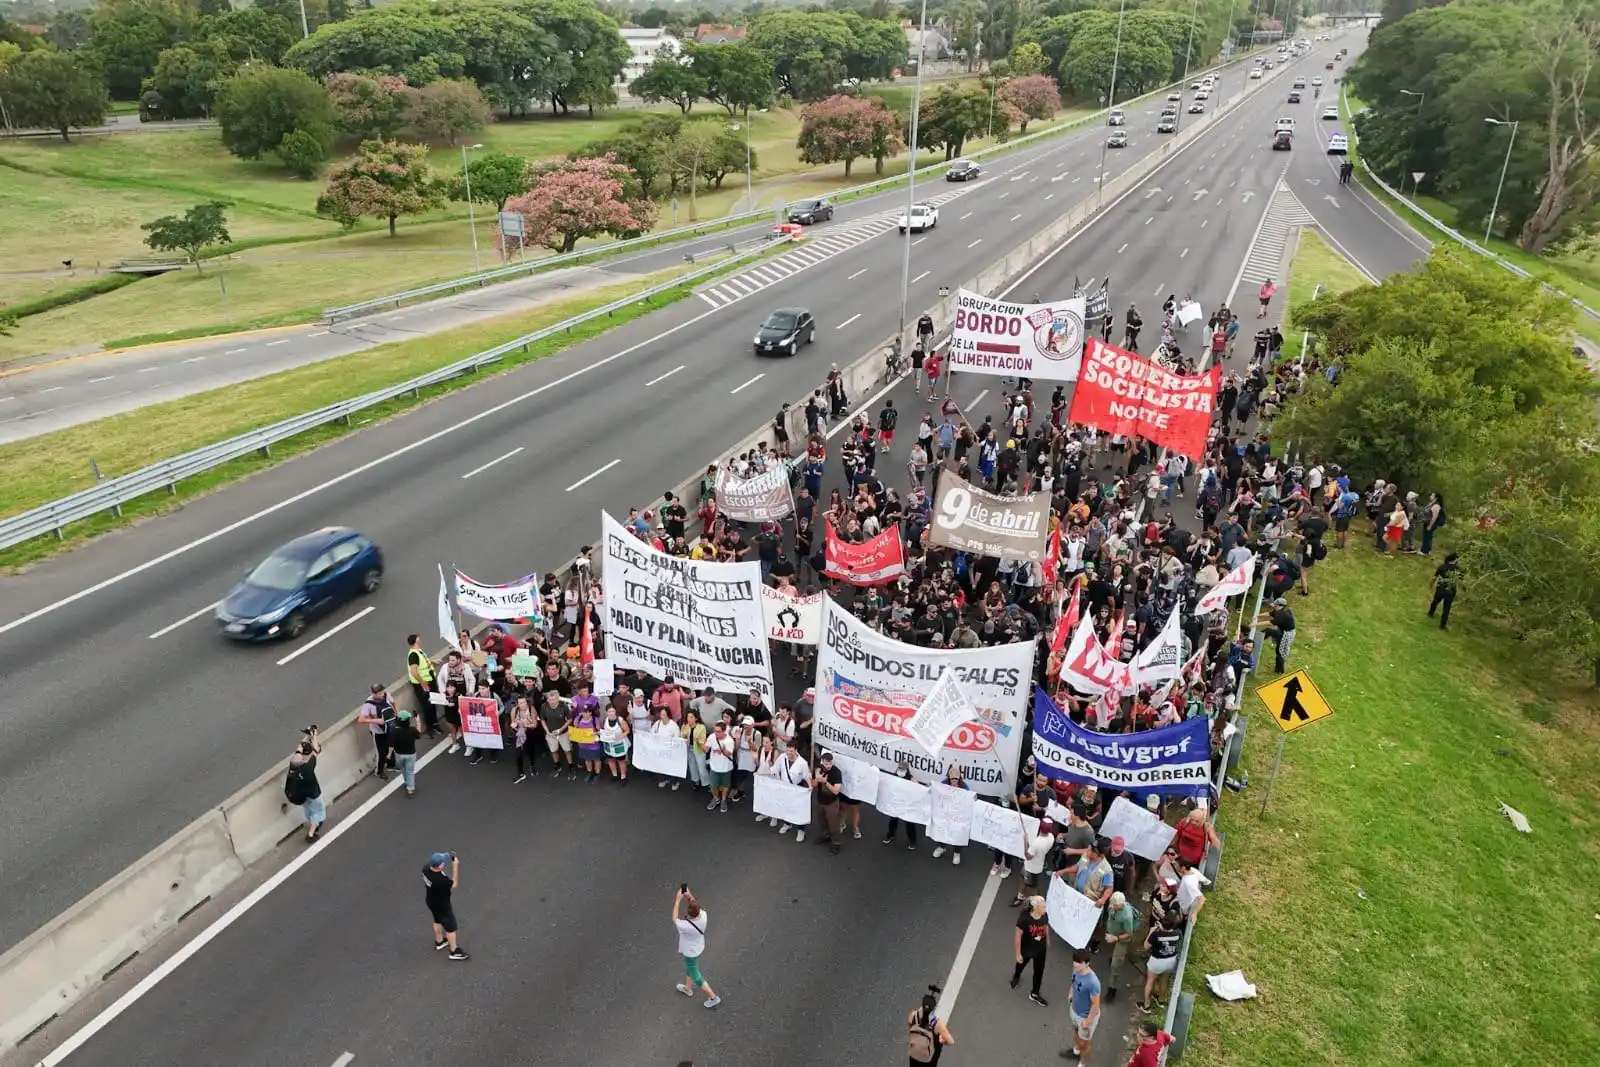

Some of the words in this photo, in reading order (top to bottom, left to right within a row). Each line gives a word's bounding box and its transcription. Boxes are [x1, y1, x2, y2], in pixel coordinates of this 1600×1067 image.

[956, 309, 1021, 336] BORDO
[963, 339, 974, 350] LA
[951, 351, 1032, 370] ALIMENTACION
[1091, 340, 1213, 391] IZQUERDA
[937, 487, 971, 530] 9
[970, 503, 988, 523] de
[990, 508, 1040, 532] abril
[625, 581, 659, 609] LOS
[771, 626, 784, 638] LA
[786, 628, 804, 640] RED
[829, 608, 849, 640] NO
[636, 648, 649, 662] DE
[645, 619, 655, 637] Y
[658, 622, 695, 650] PLAN
[714, 646, 765, 666] LUCHA
[827, 627, 916, 679] DESPIDOS
[1003, 687, 1016, 697] EN
[833, 696, 994, 750] GEOROS
[959, 764, 1003, 784] HUELGA
[1065, 756, 1133, 782] GESTIÓN
[1137, 766, 1206, 782] OBRERA
